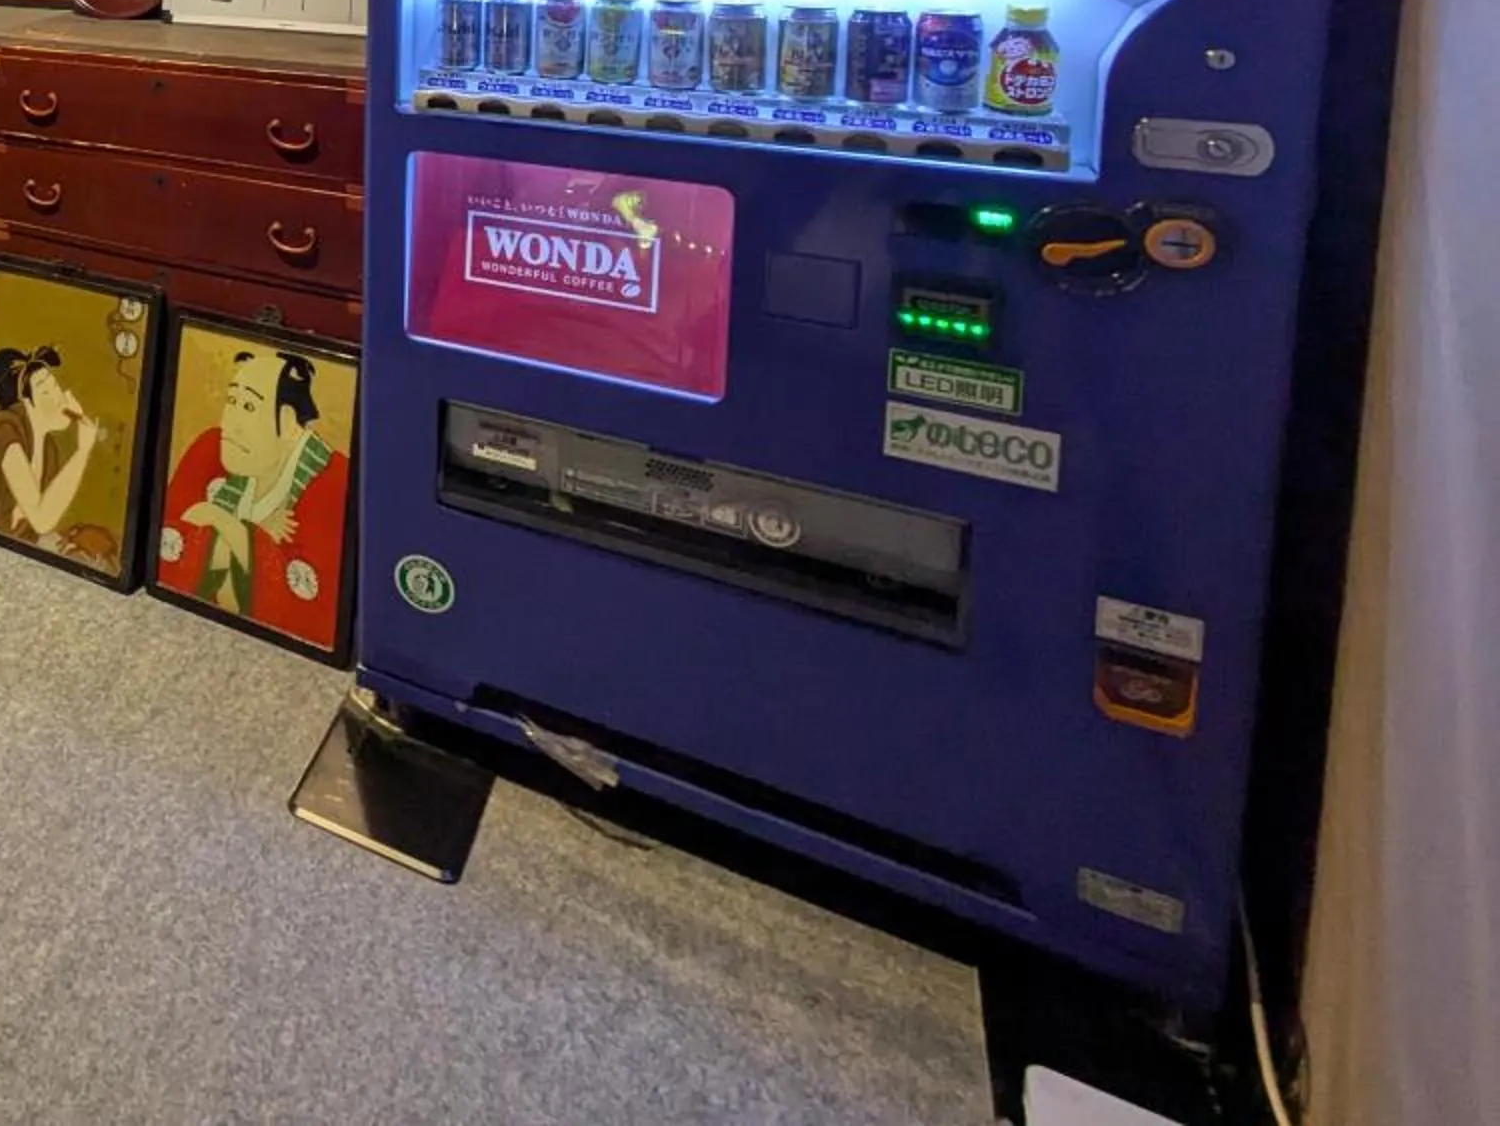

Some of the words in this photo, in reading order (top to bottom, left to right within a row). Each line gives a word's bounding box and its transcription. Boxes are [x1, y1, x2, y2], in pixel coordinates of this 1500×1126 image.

[483, 226, 641, 282] WONDA
[481, 260, 558, 284] WONDERFUL
[563, 274, 616, 295] COFFEE
[904, 370, 1004, 407] LED照明
